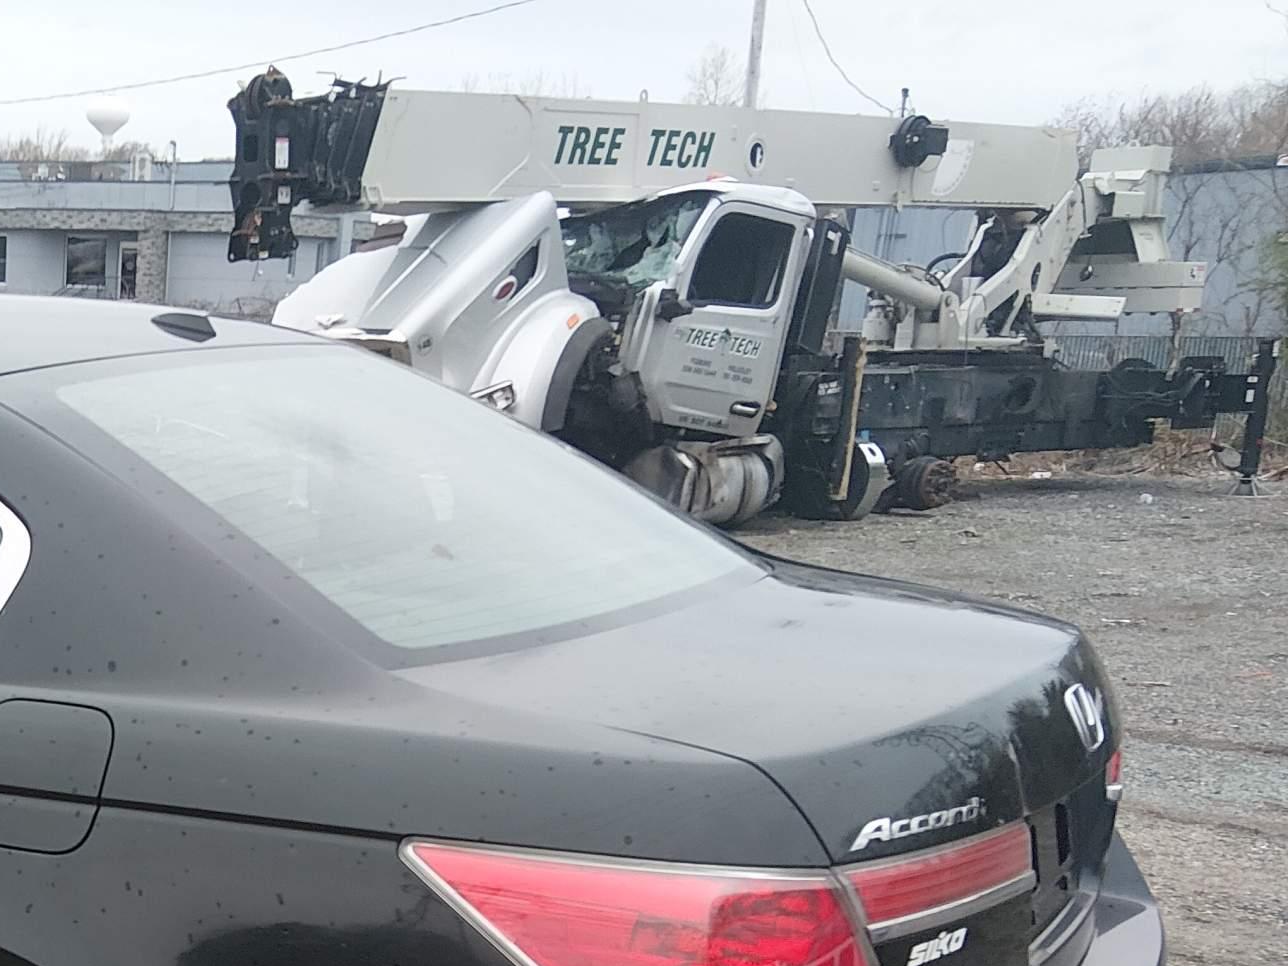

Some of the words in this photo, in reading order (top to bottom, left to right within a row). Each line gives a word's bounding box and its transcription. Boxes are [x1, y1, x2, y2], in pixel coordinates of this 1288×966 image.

[554, 125, 626, 166] TREE
[647, 128, 716, 169] TECH
[686, 327, 720, 348] TREE
[729, 336, 762, 357] TECH
[849, 796, 981, 851] Accord
